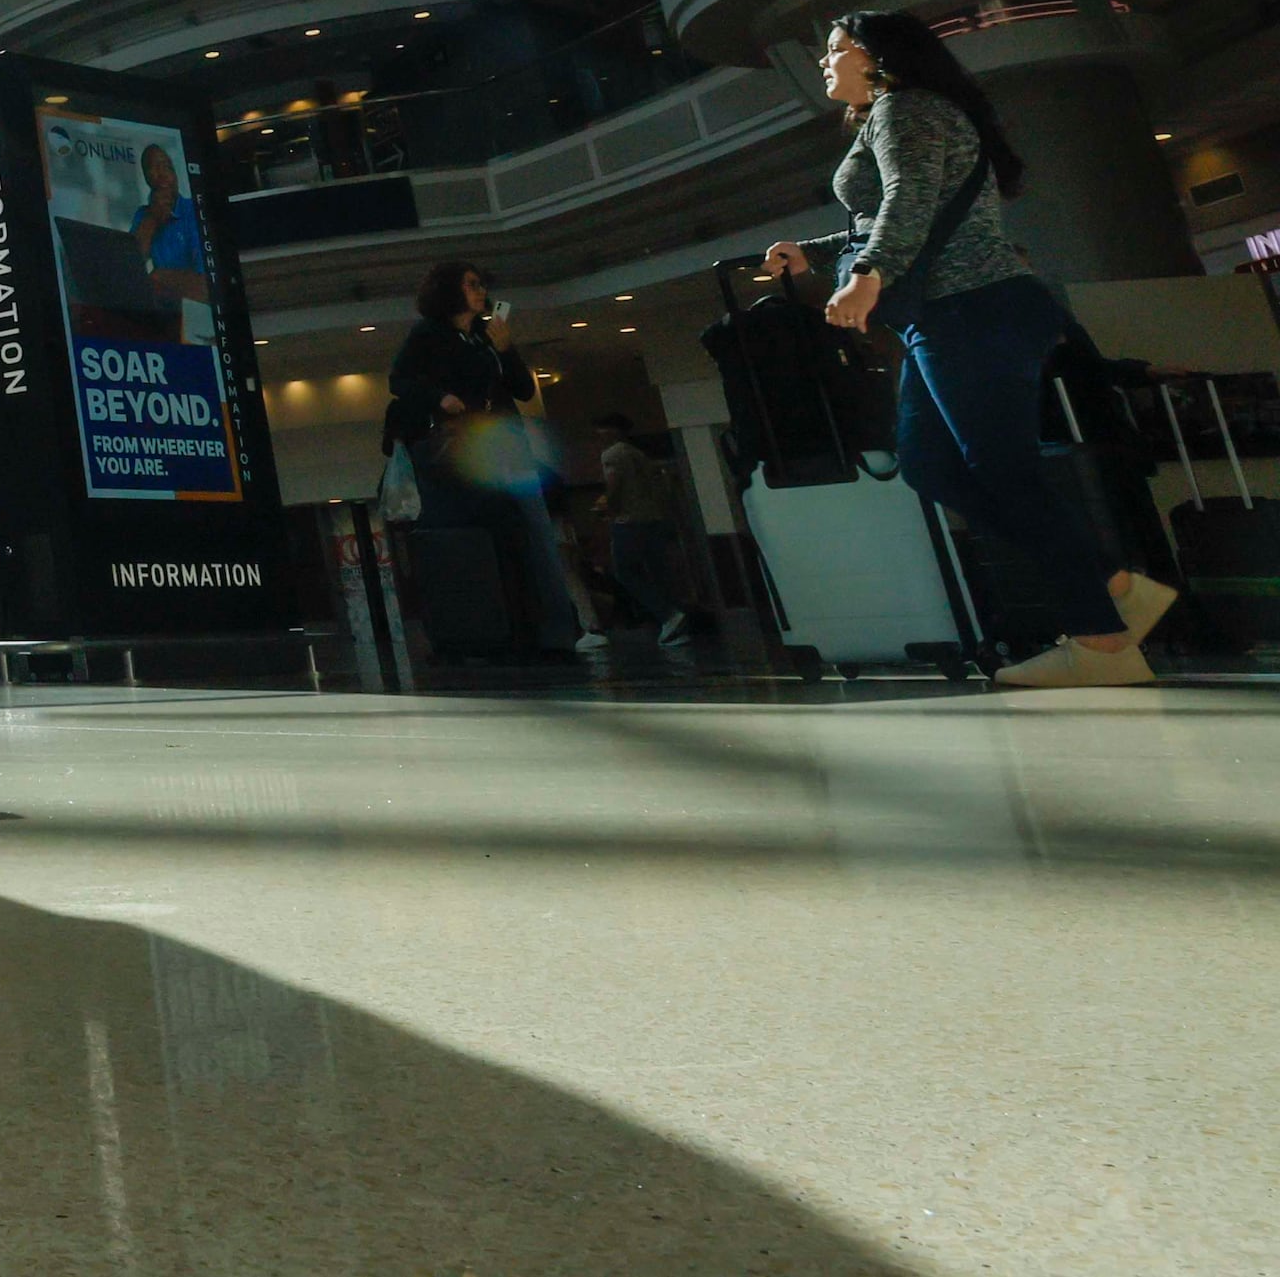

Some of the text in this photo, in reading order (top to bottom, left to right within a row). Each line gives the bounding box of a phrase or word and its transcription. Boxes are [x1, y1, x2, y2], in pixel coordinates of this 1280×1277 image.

[74, 139, 137, 164] ONLINE
[196, 193, 252, 482] FLIGHT INFORMATION
[80, 346, 168, 385] SOAR
[85, 387, 219, 427] BEYOND.
[92, 435, 226, 457] FROM WHEREVER
[96, 456, 169, 476] YOU ARE.
[111, 563, 262, 588] INFORMATION
